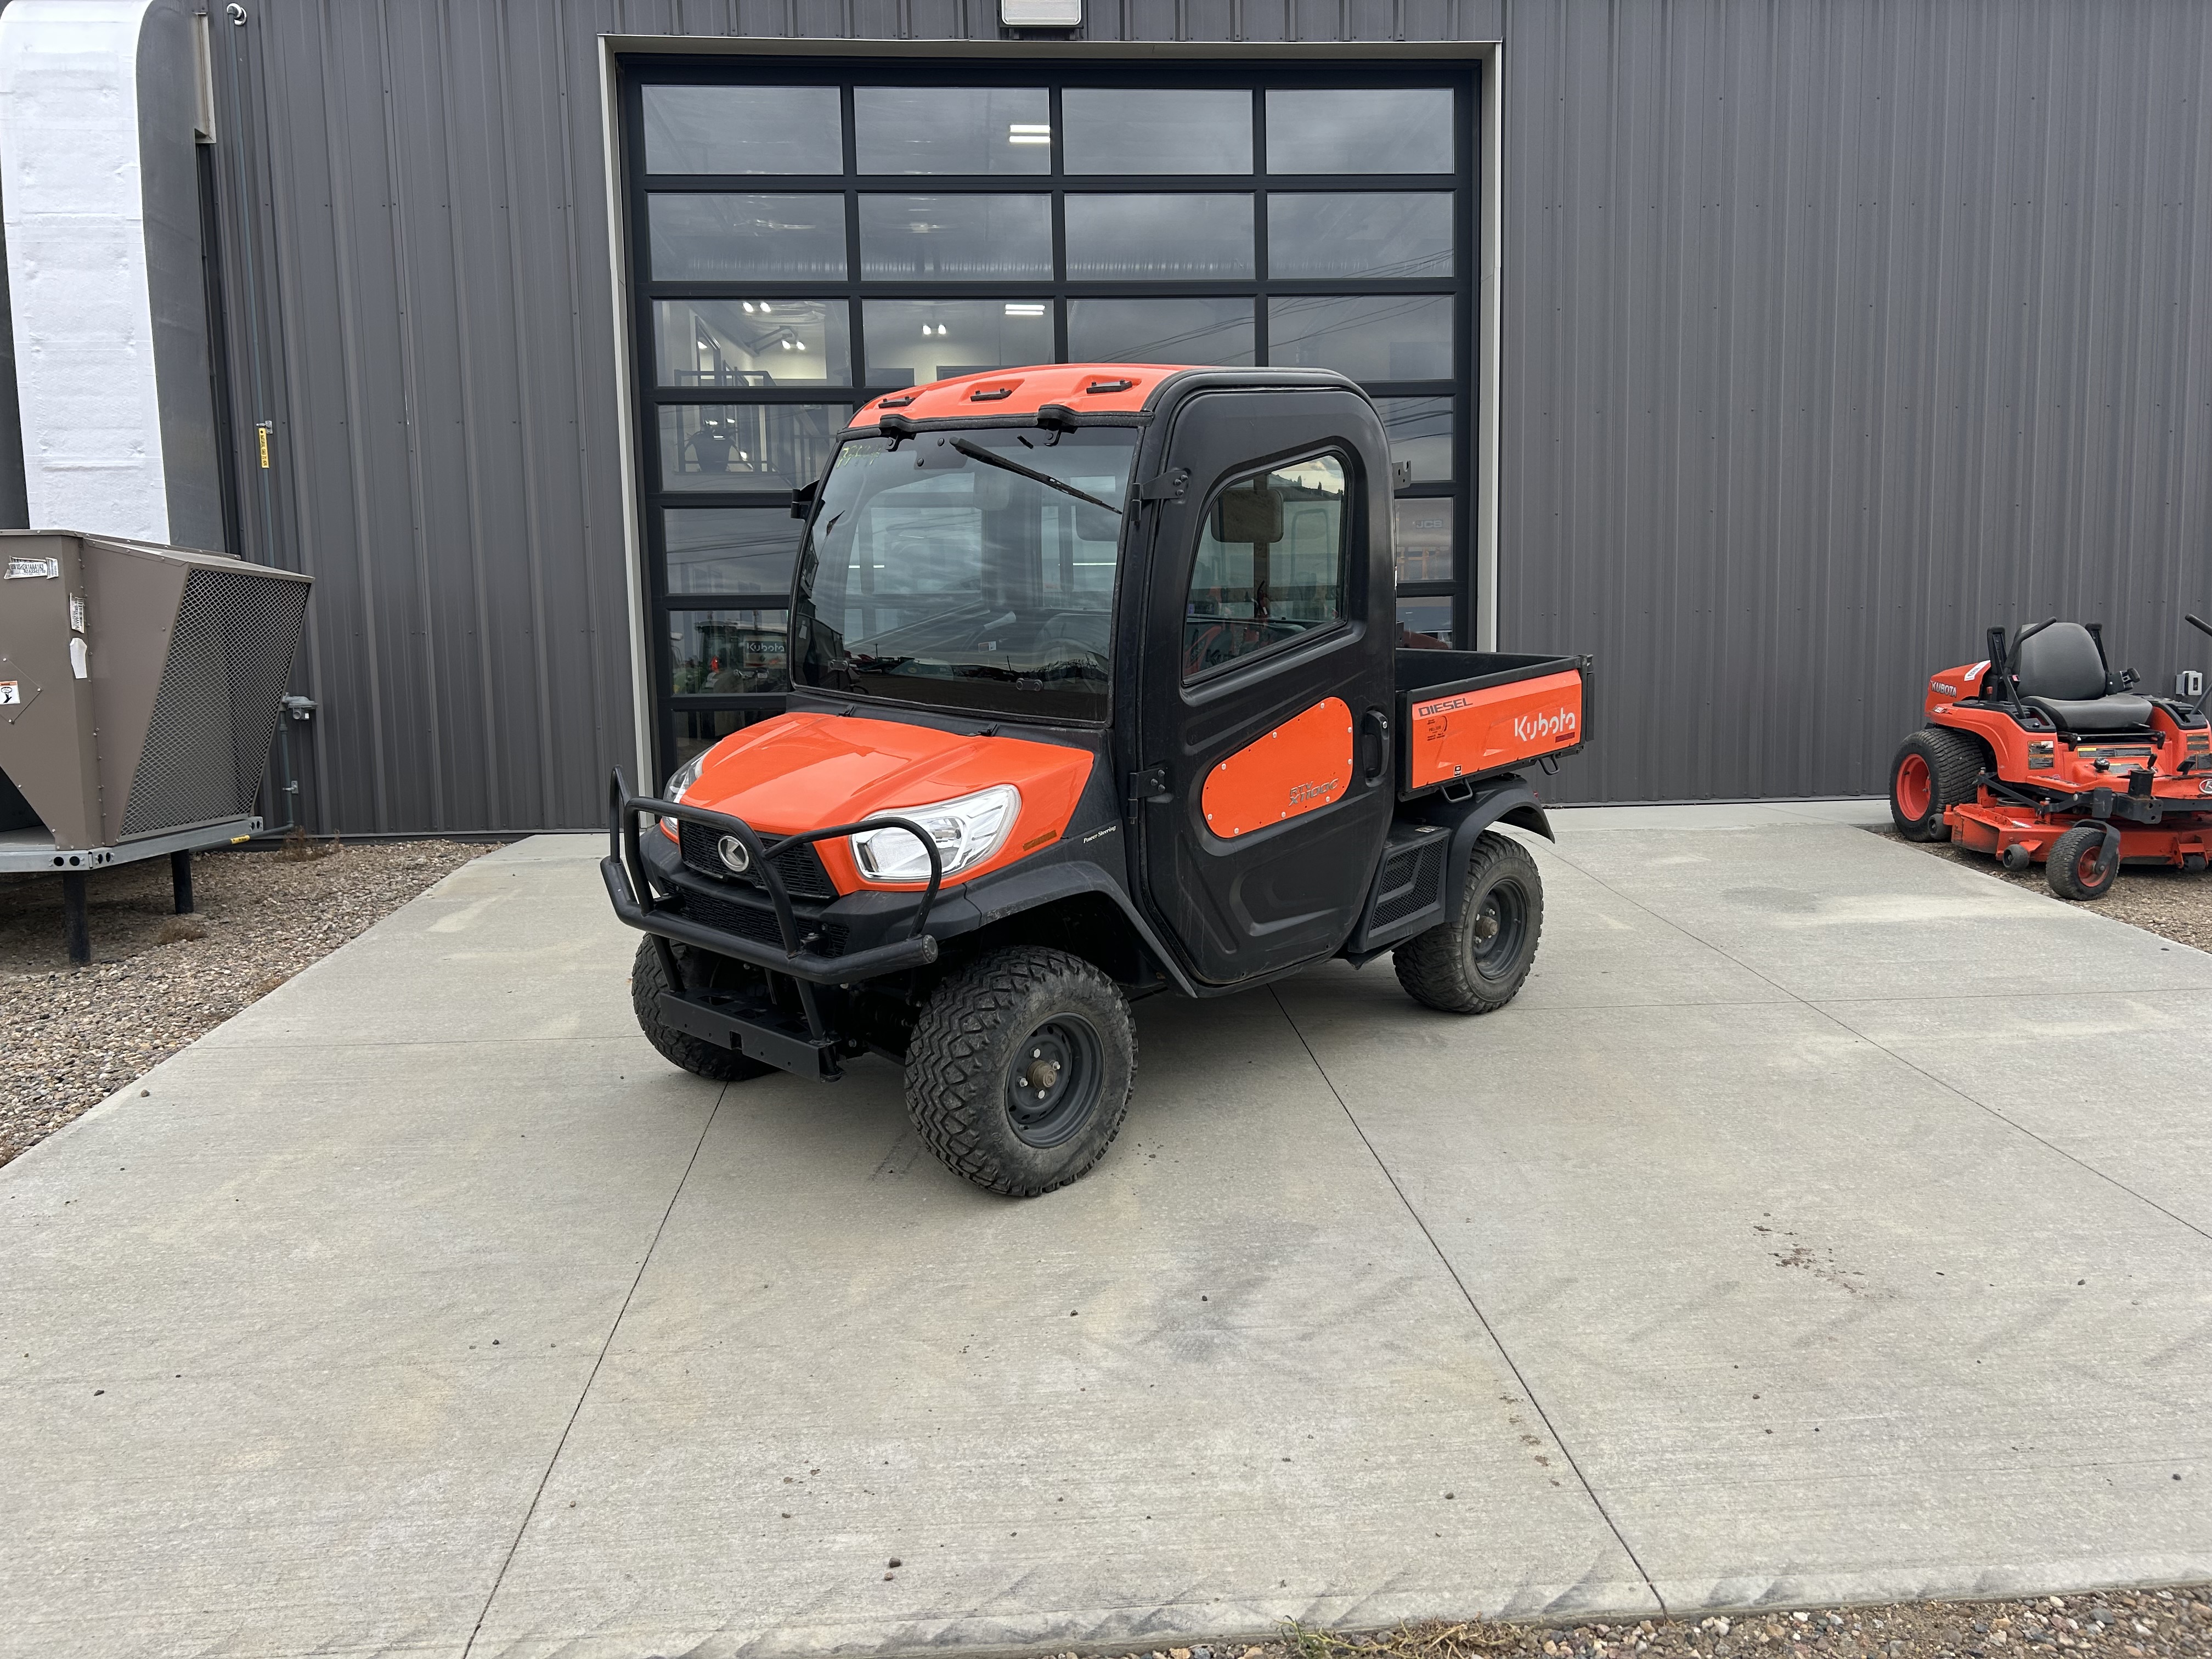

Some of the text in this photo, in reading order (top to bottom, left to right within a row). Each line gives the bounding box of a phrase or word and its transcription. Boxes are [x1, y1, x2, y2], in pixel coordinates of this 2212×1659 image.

[1416, 520, 1443, 529] JCB
[747, 641, 785, 652] Kubota
[1931, 680, 1957, 698] KUBOTA
[1418, 698, 1473, 717] DIESEL
[1515, 707, 1575, 742] Kubota
[1288, 778, 1339, 807] X1100C
[1290, 781, 1313, 797] RTV
